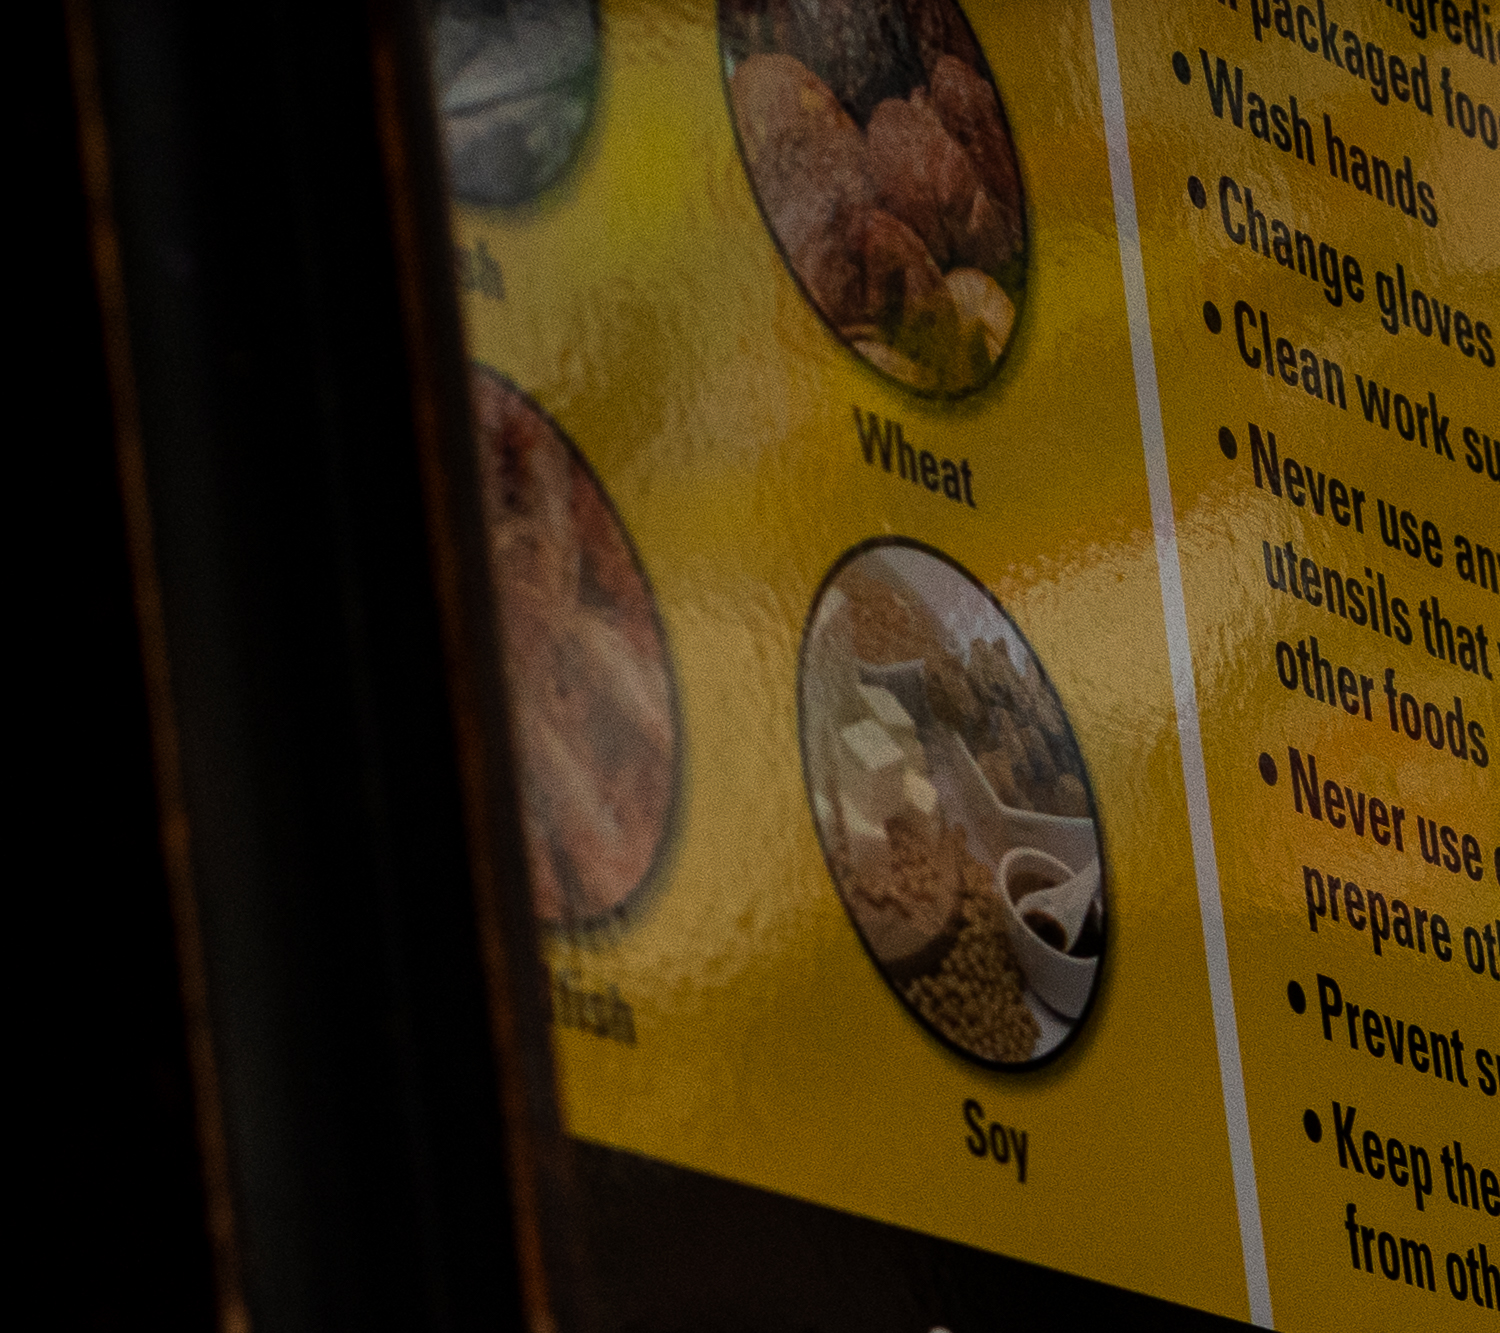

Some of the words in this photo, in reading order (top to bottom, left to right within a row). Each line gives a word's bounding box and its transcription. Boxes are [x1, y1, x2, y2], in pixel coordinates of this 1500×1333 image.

[1251, 0, 1434, 116] packaged
[1200, 49, 1315, 167] Wash
[1326, 115, 1439, 229] hands
[1218, 176, 1366, 308] Change
[1376, 264, 1497, 369] gloves
[1234, 300, 1348, 411] Clean
[1356, 371, 1454, 462] work
[854, 406, 977, 510] Wheat
[1248, 422, 1366, 534] Never
[1378, 503, 1444, 571] use
[1263, 540, 1412, 647] utensils
[1420, 601, 1488, 679] that
[1277, 639, 1374, 724] other
[1384, 671, 1489, 770] foods
[1287, 746, 1405, 853] Never
[1417, 812, 1483, 882] use
[1303, 863, 1454, 965] prepare
[1316, 973, 1469, 1090] Prevent
[962, 1097, 1028, 1185] Soy
[1331, 1101, 1433, 1211] Keep
[1440, 1140, 1500, 1218] the
[1345, 1203, 1436, 1295] from
